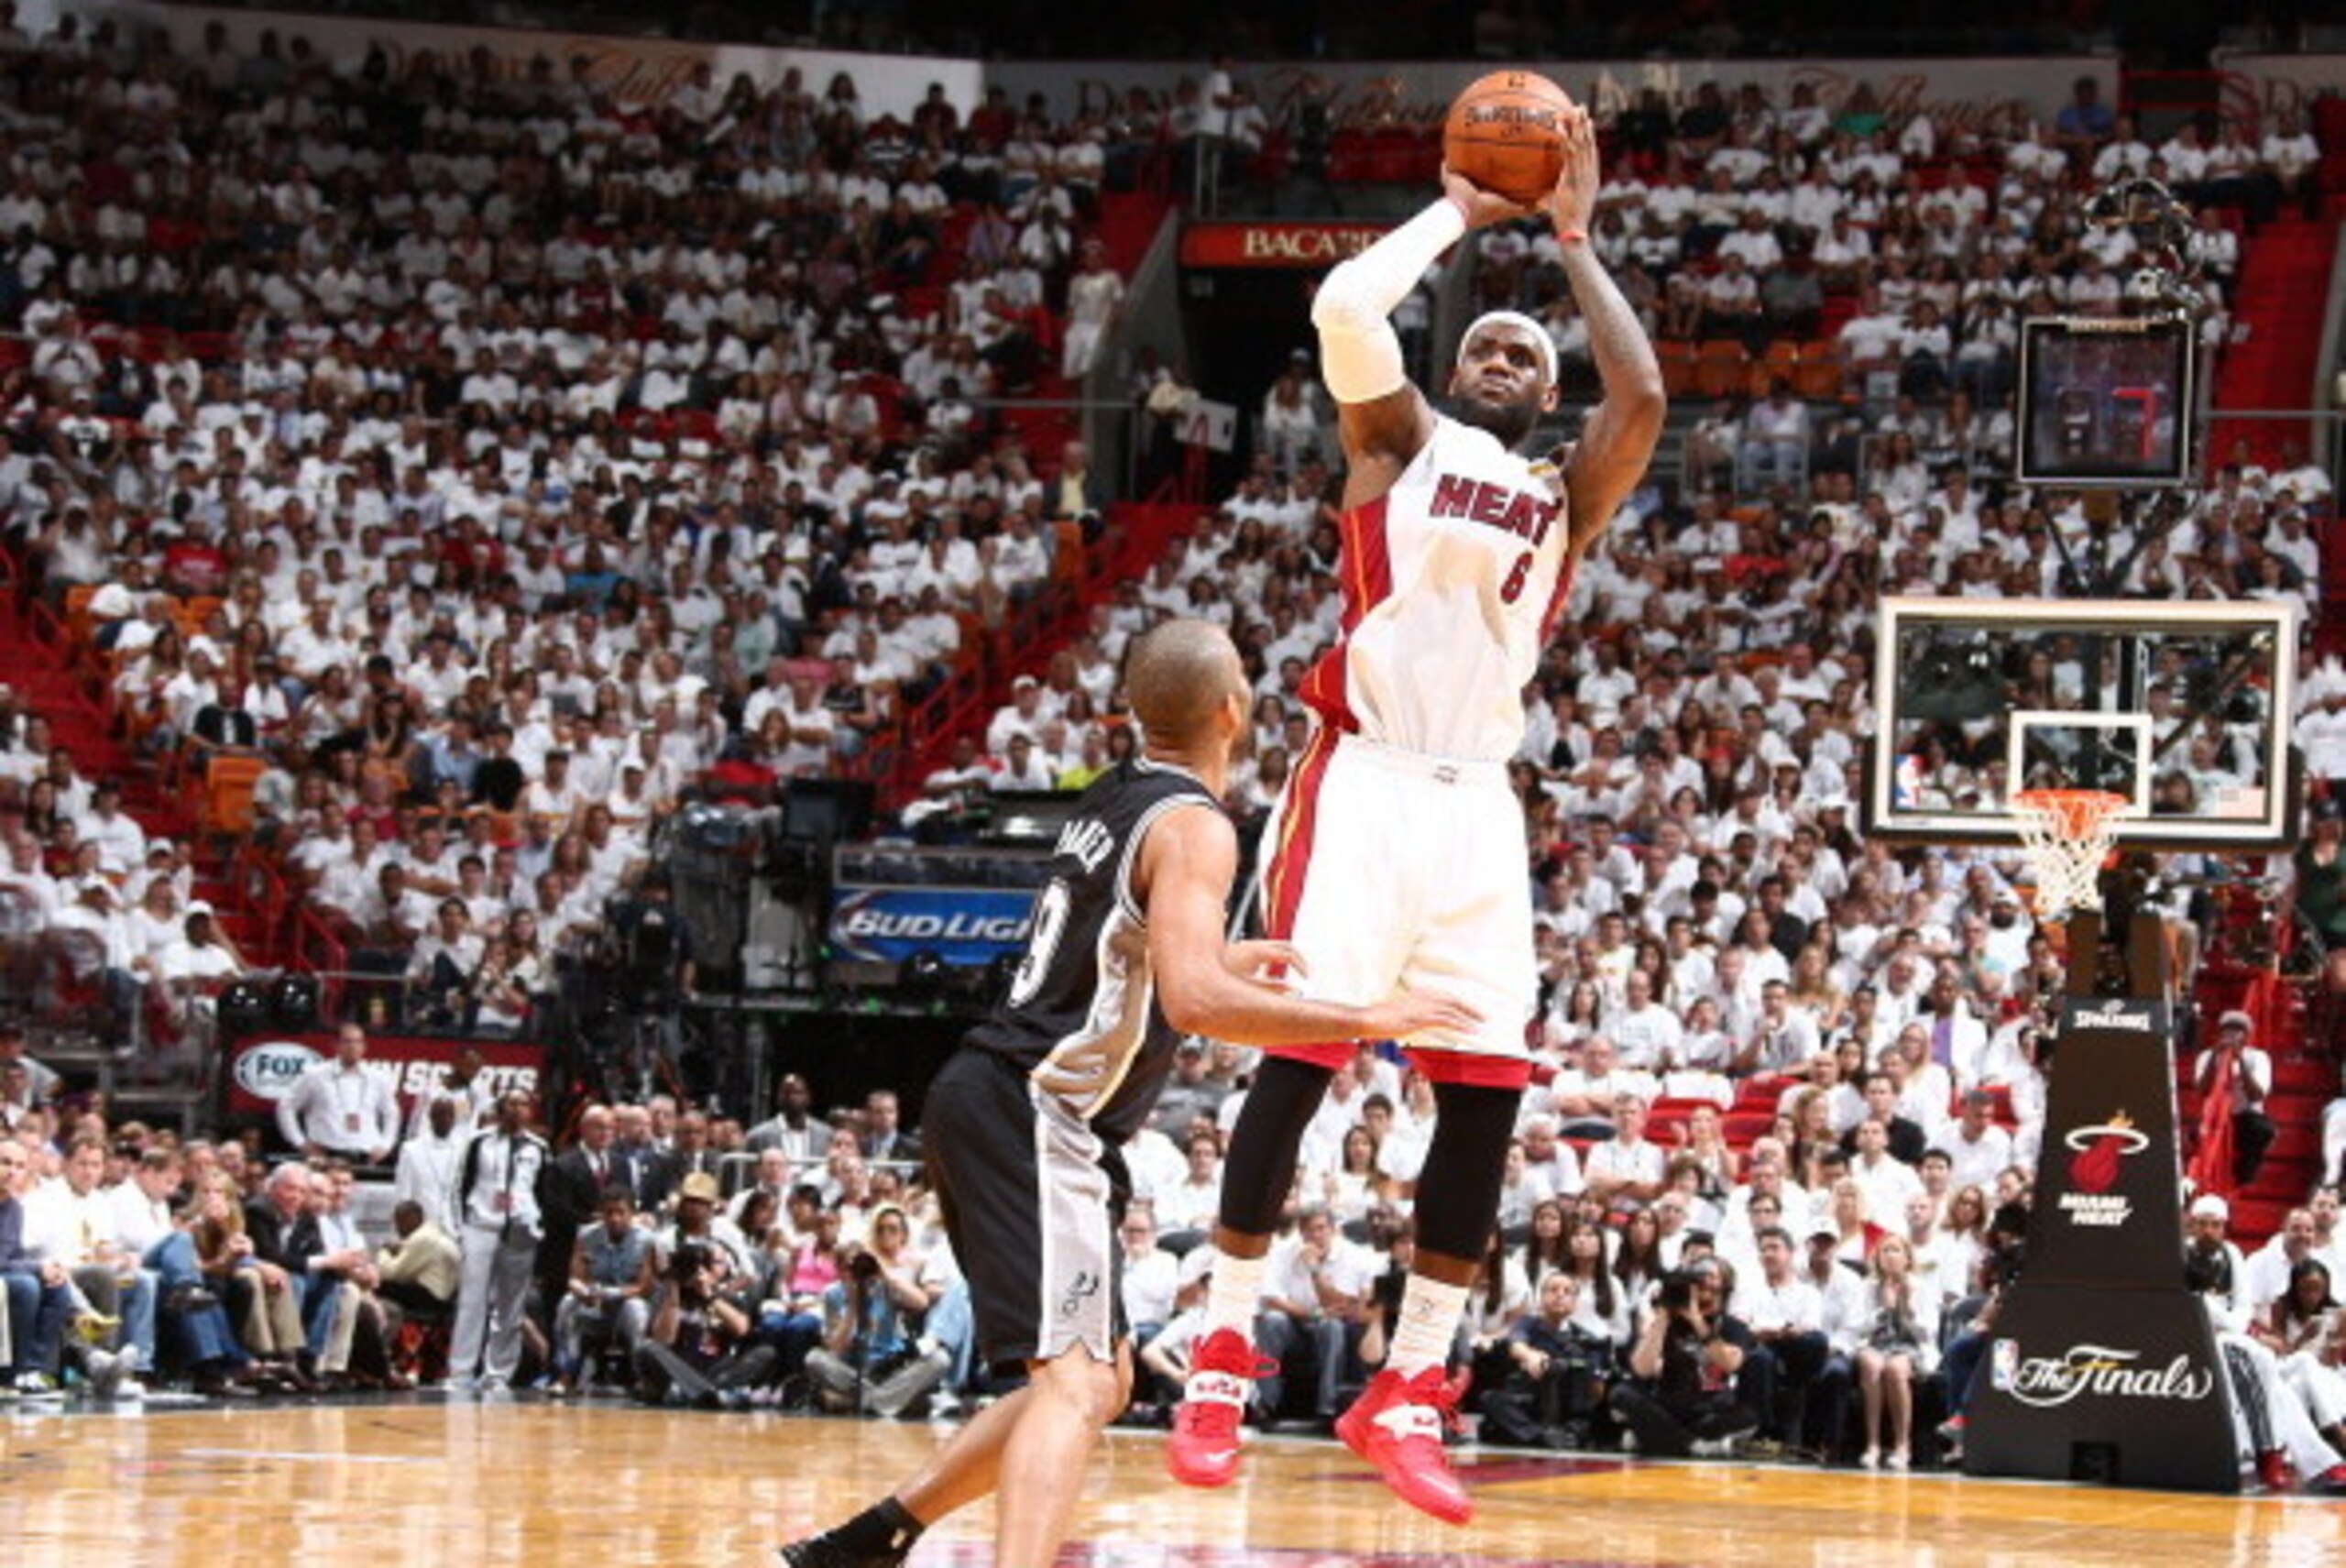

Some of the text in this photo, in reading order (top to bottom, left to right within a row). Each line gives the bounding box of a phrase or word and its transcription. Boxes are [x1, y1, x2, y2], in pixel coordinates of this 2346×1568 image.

[1429, 473, 1564, 548] HEAT
[1500, 551, 1533, 605] 6
[848, 910, 944, 938] BUD
[1008, 876, 1071, 1008] 9
[257, 1054, 305, 1075] FOX
[2012, 1345, 2213, 1407] The Finals
